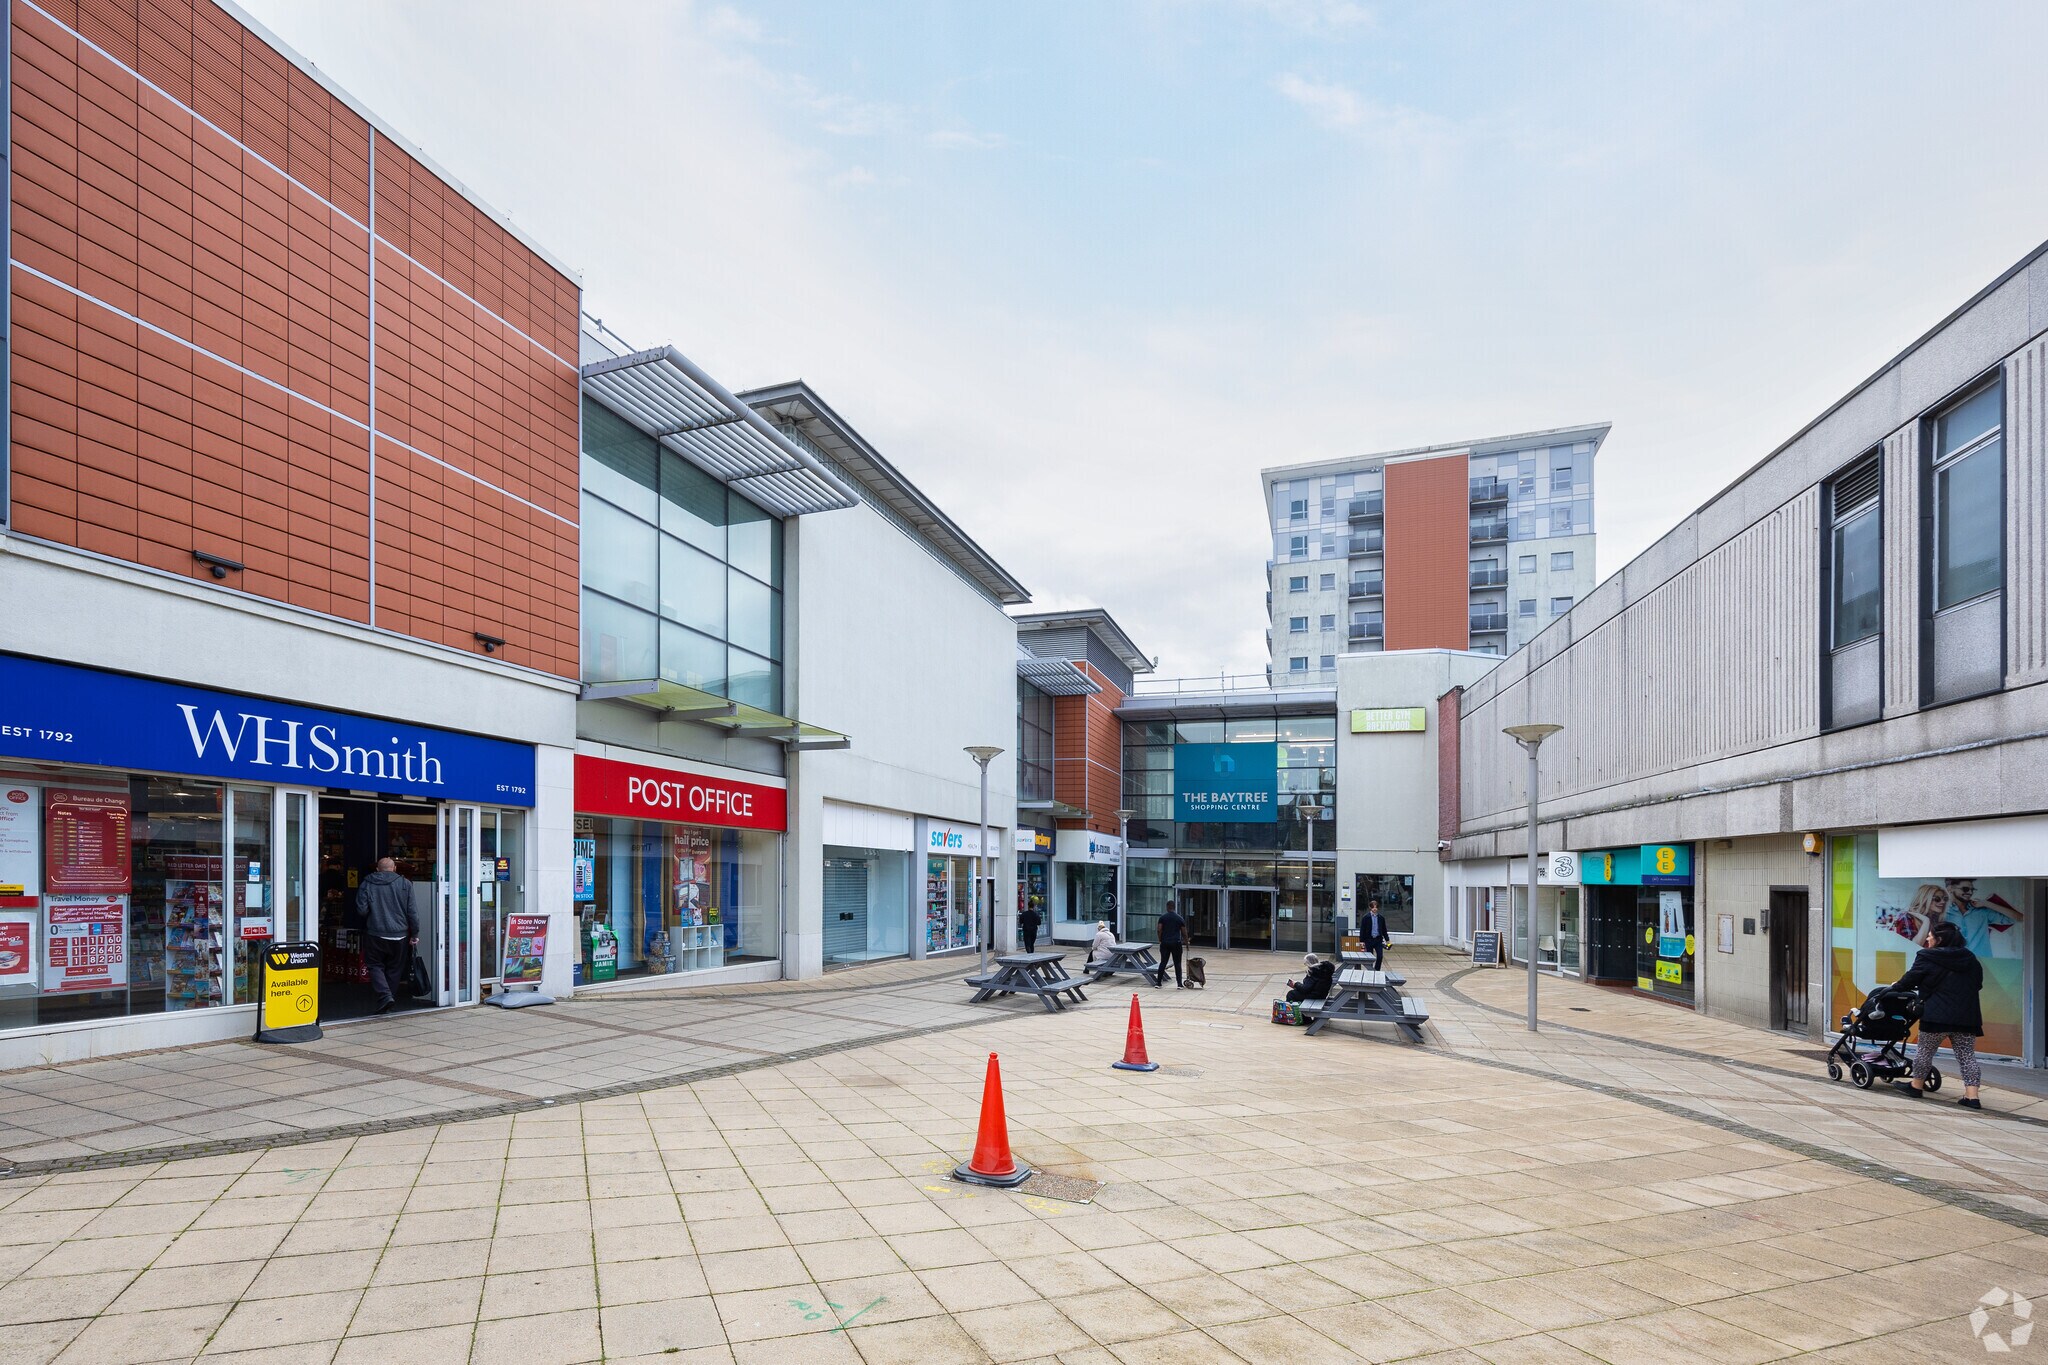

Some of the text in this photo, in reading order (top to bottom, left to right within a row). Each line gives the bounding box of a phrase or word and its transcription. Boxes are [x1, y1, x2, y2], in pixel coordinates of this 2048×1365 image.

[1366, 711, 1393, 720] BETTER
[1366, 721, 1410, 731] BRENTWOOD
[2, 725, 73, 743] EST 1792
[176, 703, 445, 785] WHSmith
[496, 784, 526, 794] EST 1792
[628, 776, 753, 817] POST OFFICE
[1182, 792, 1268, 803] THE BAYTREE
[674, 834, 710, 847] half price
[931, 827, 963, 849] savers
[1554, 855, 1574, 877] 3
[74, 895, 99, 903] Money
[511, 917, 516, 925] In
[271, 979, 308, 988] Available
[271, 989, 293, 997] here.
